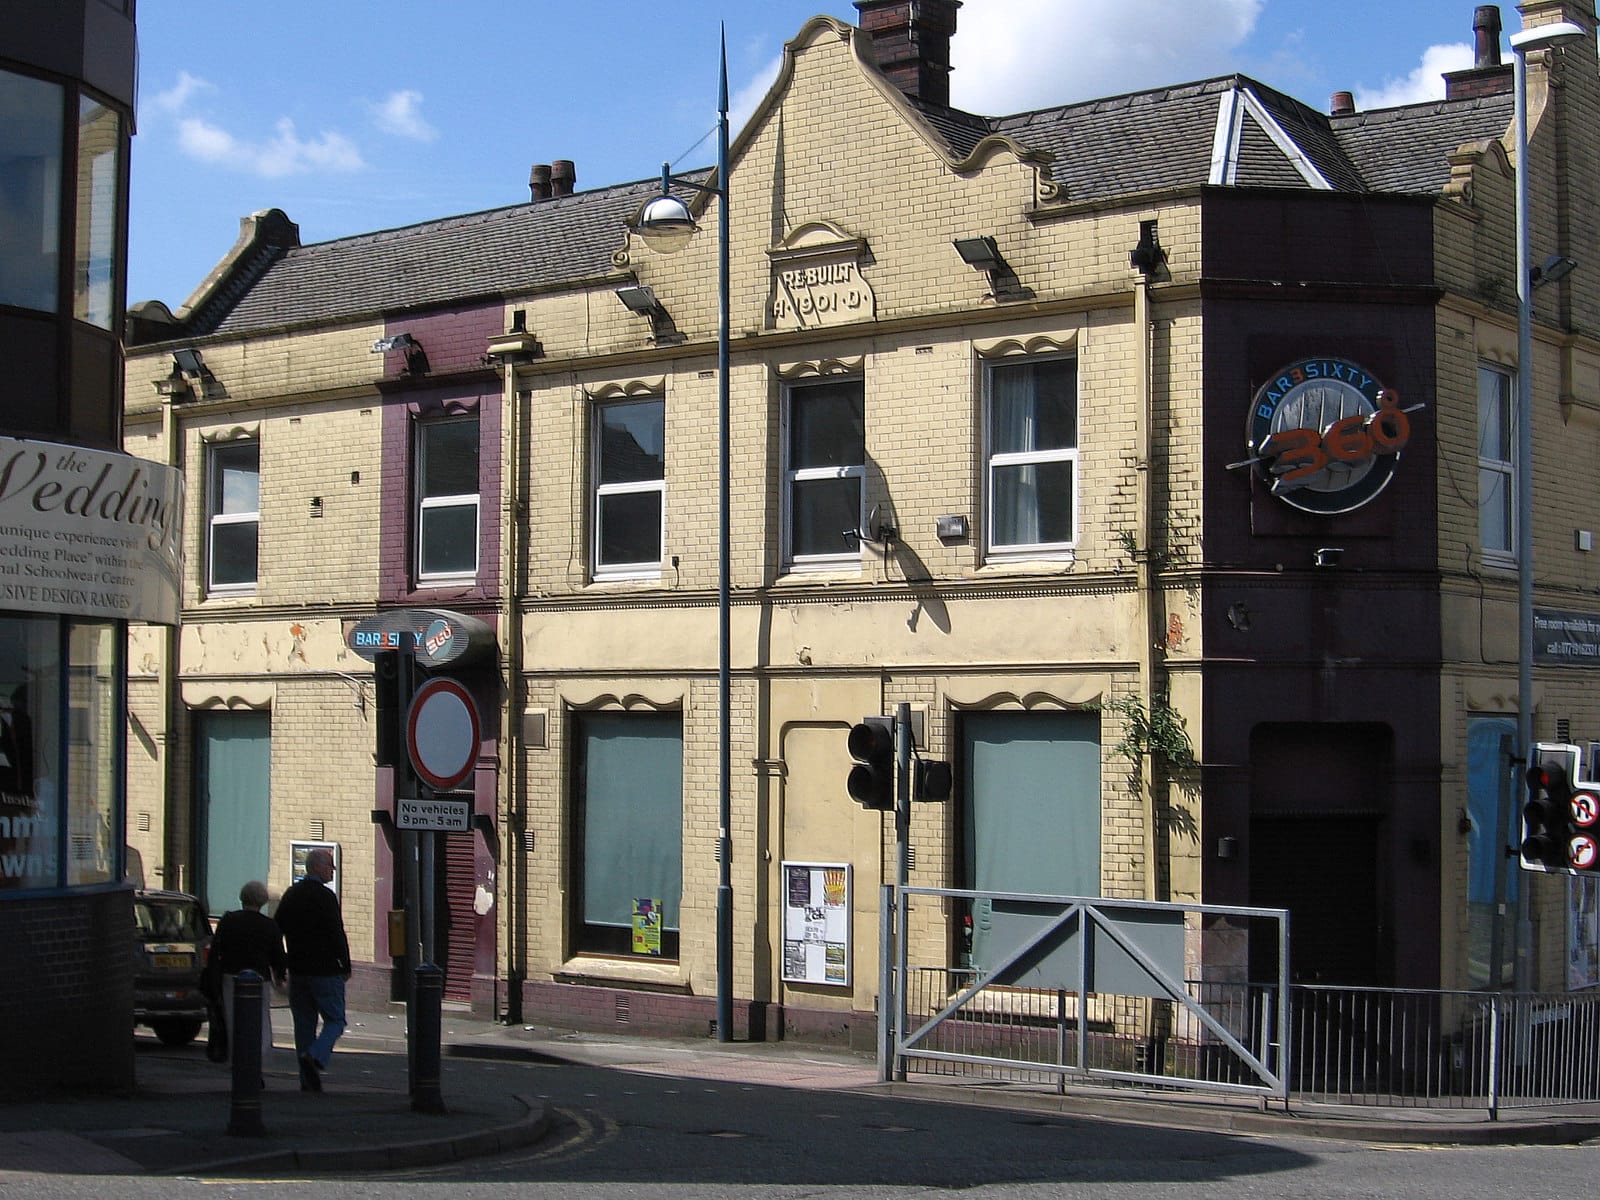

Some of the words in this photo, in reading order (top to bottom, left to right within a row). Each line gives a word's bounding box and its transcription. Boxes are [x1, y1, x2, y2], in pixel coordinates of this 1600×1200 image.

[781, 263, 853, 290] REBUILT
[56, 452, 87, 473] the
[54, 532, 118, 549] experience
[95, 554, 128, 570] within
[25, 564, 99, 584] Schoolwear
[102, 572, 134, 588] Centre
[42, 585, 89, 606] DESIGN
[90, 590, 130, 609] RANGES
[356, 631, 424, 647] BAR3SIY
[402, 803, 417, 813] No
[420, 804, 465, 815] vehicles
